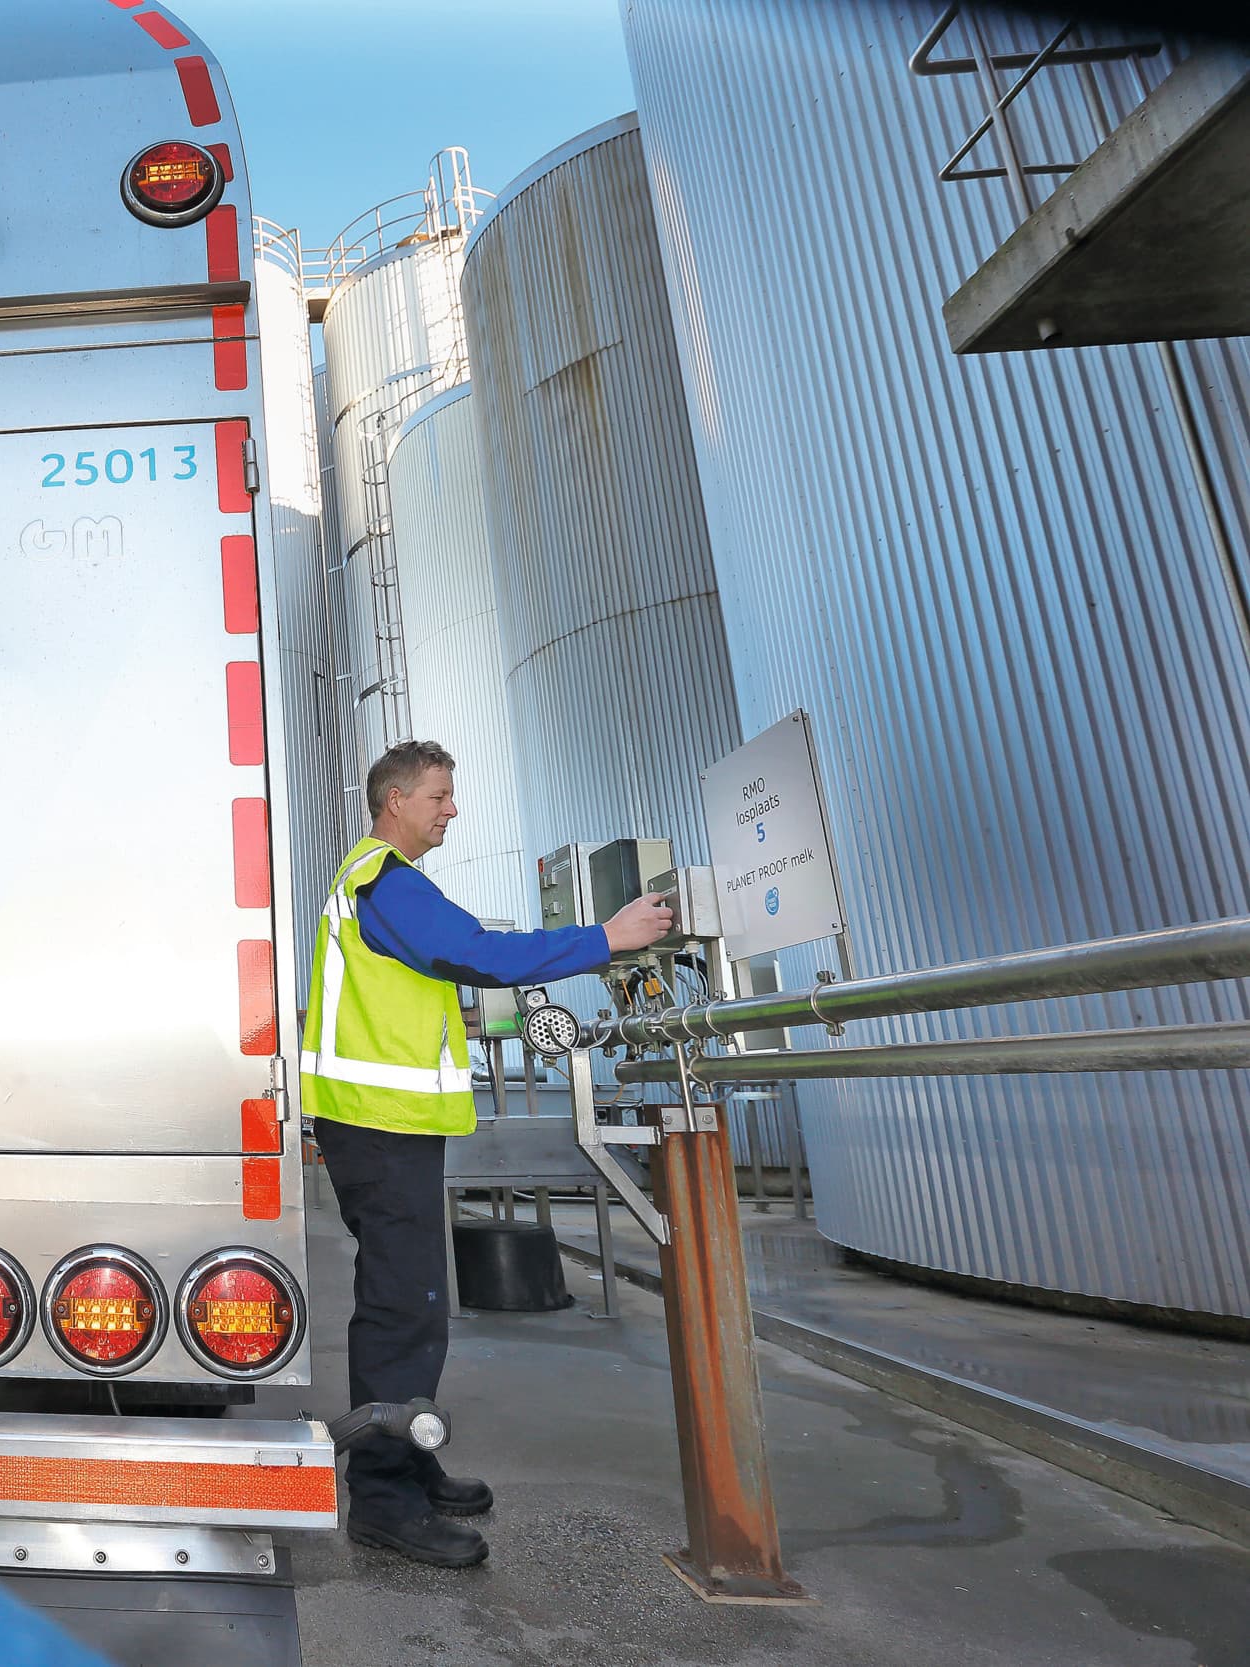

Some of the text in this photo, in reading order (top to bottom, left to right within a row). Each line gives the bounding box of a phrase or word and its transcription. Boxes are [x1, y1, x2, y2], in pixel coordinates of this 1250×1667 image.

[40, 445, 198, 488] 25013
[742, 777, 765, 801] RMO
[736, 793, 780, 826] losplaats
[756, 822, 766, 843] 5
[726, 848, 815, 893] PLANET PROOF melk
